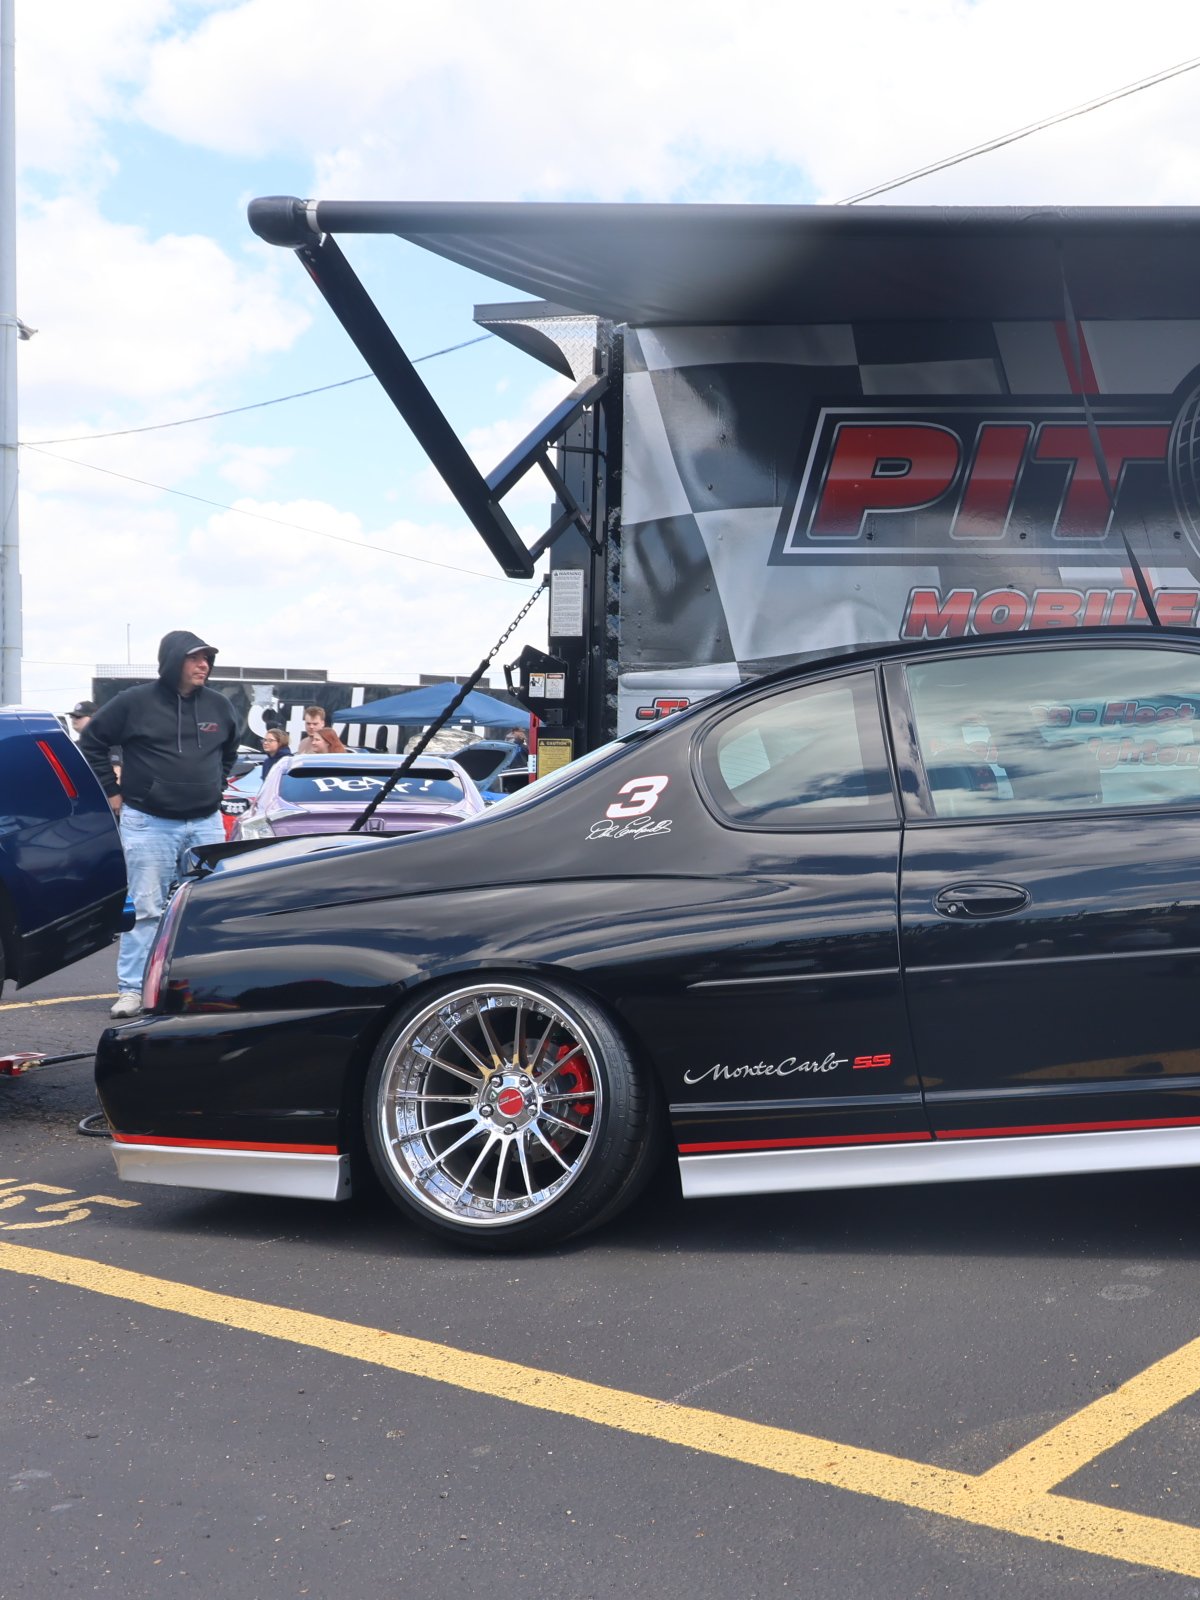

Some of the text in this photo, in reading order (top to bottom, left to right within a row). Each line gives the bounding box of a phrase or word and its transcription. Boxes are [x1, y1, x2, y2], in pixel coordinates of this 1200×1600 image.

[805, 420, 1174, 541] PIT
[606, 774, 670, 819] 3
[852, 1054, 891, 1069] SS
